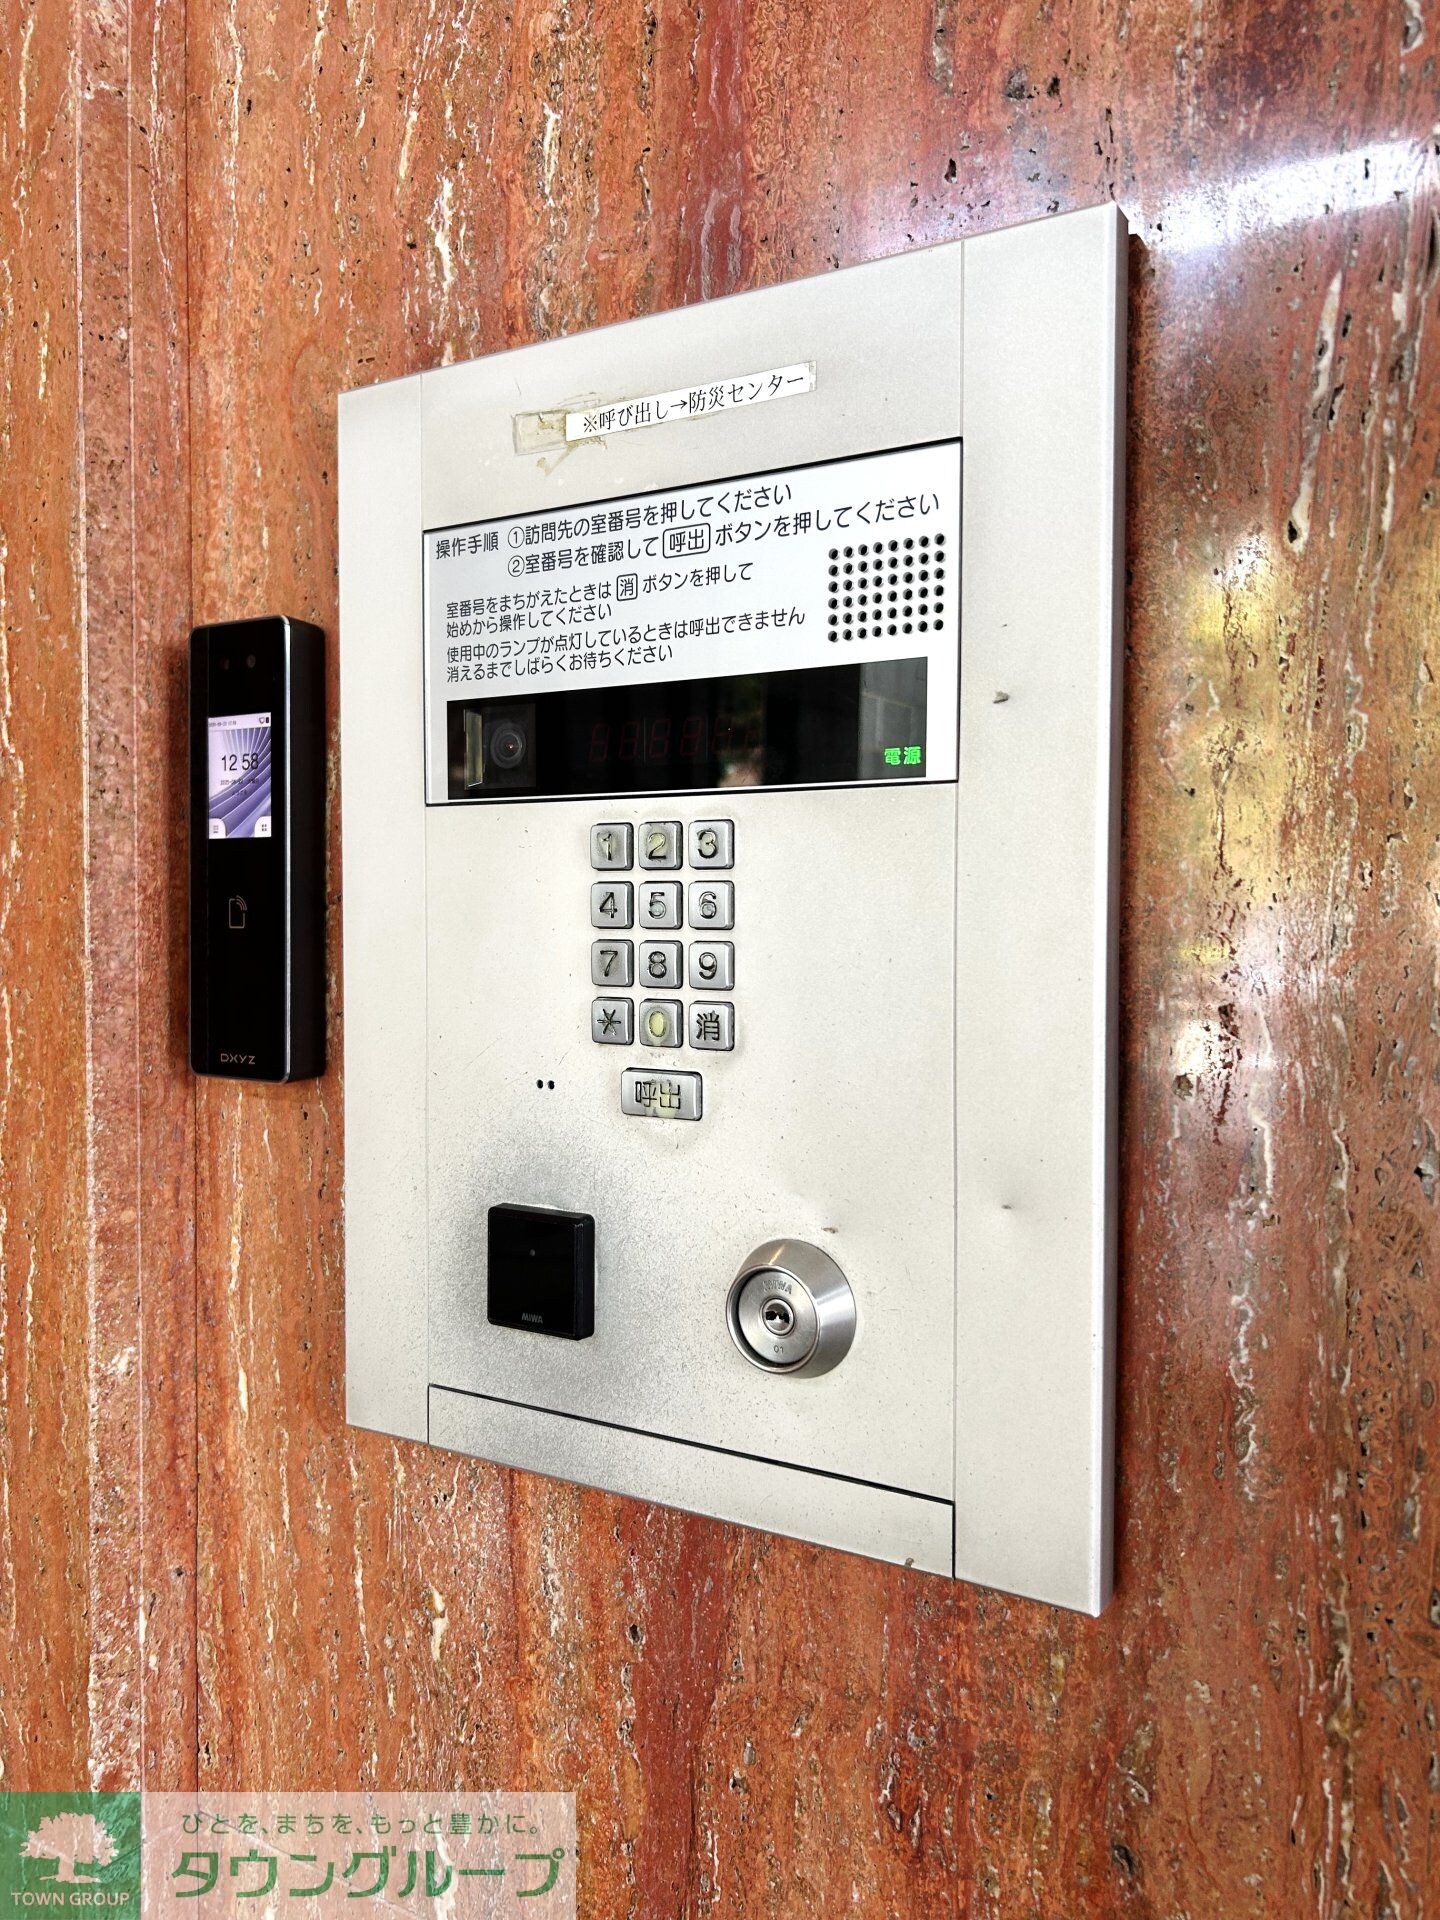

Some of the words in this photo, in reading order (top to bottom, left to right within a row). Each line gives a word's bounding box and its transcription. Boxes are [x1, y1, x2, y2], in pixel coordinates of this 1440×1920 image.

[715, 493, 939, 546] ボタンを押してください
[436, 531, 499, 560] 操作手順
[446, 581, 612, 619] 室番号をまちがえたときは
[642, 562, 754, 594] ボタンを押して
[446, 603, 612, 639] 始めから操作してください
[446, 606, 805, 664] 使用中のランプが点灯しているときは呼出できません
[446, 644, 673, 683] 消えるまでしばらくお待ちください
[884, 745, 922, 766] 電源
[648, 832, 667, 860] 2
[697, 829, 718, 859] 3
[599, 891, 618, 919] 4
[648, 891, 667, 919] 5
[699, 891, 717, 919] 6
[600, 950, 618, 977] 7
[648, 951, 667, 979] 8
[699, 952, 717, 980] 9
[649, 1010, 667, 1038] 0
[696, 1010, 720, 1041] 消
[220, 1053, 256, 1065] DXYZ
[635, 1079, 681, 1109] 呼出
[521, 1312, 544, 1324] MIWA
